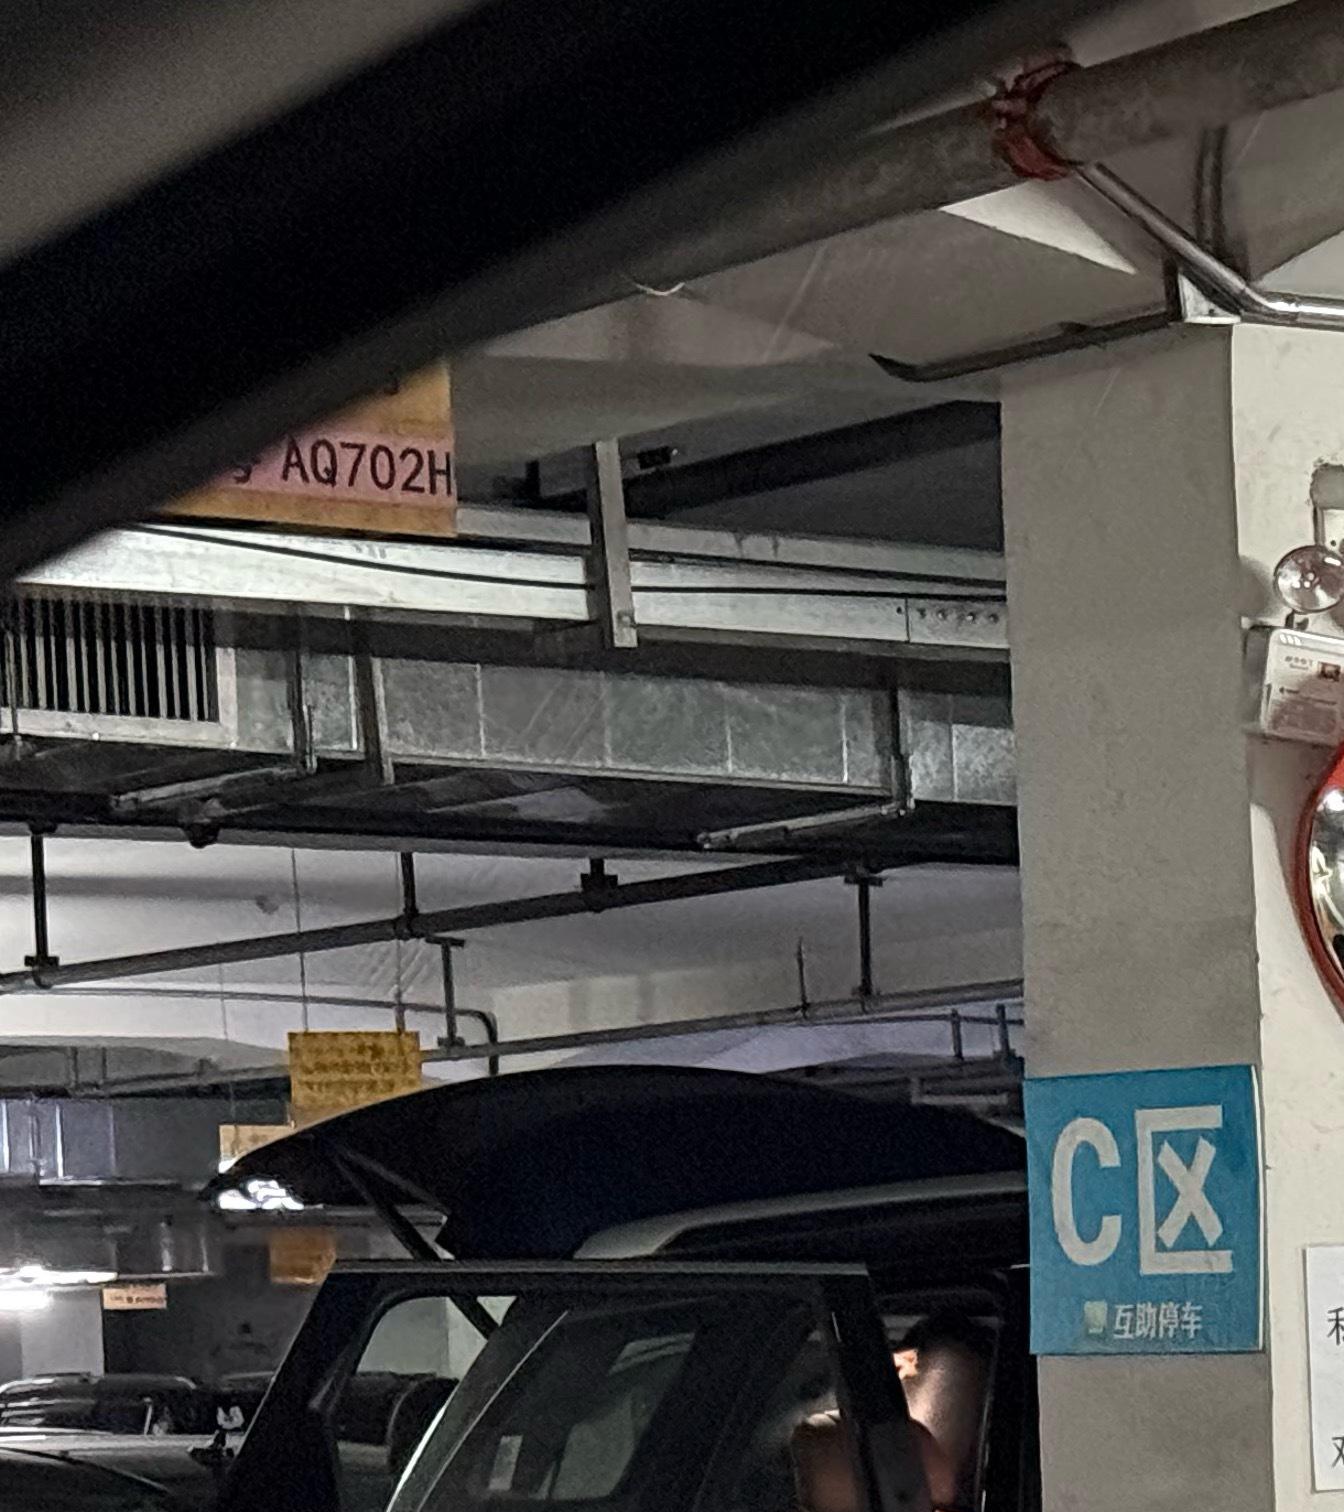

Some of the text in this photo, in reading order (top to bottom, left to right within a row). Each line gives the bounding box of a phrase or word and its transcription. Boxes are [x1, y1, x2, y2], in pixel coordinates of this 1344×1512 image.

[281, 433, 453, 497] AQ702H
[1050, 1104, 1233, 1276] C区
[1112, 1301, 1203, 1340] 互助停车
